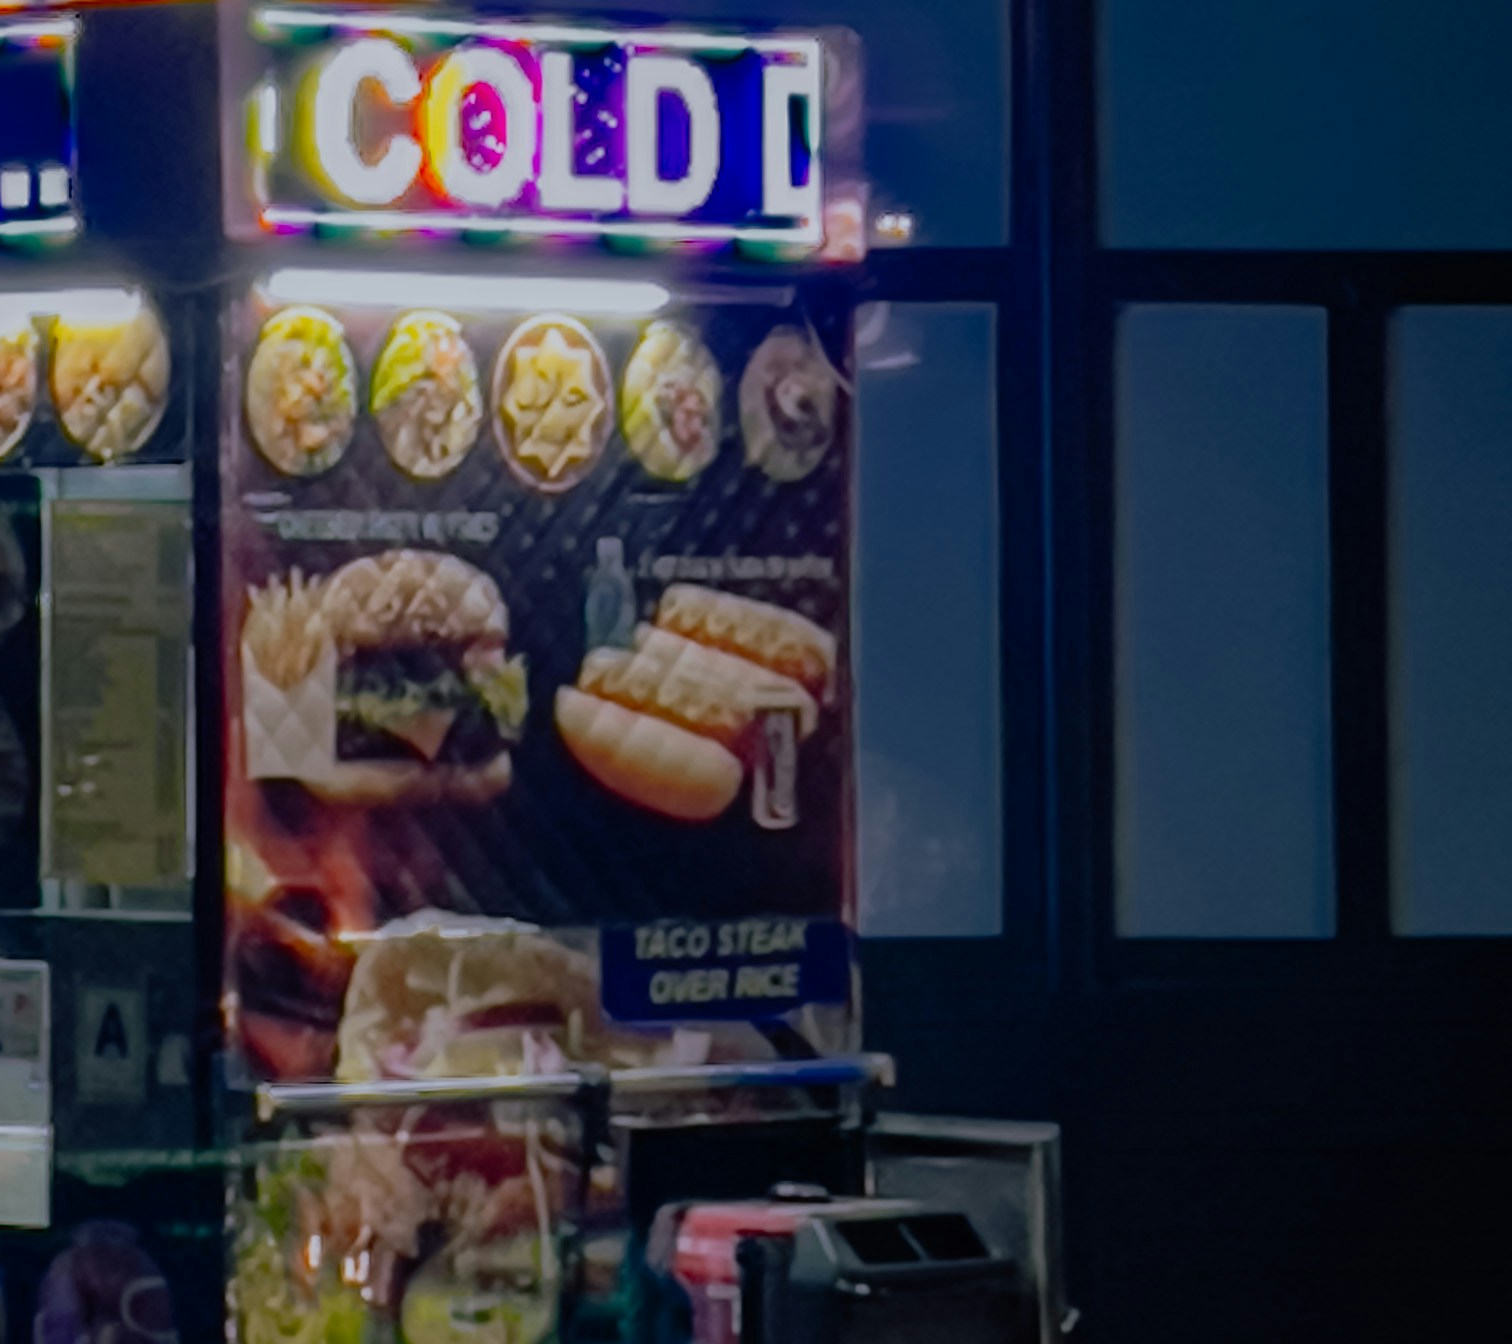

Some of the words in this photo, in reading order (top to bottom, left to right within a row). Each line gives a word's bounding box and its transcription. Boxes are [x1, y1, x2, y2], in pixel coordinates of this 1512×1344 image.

[315, 36, 723, 216] COLD
[634, 922, 711, 960] TACO
[716, 915, 808, 956] STEAK
[648, 967, 730, 1006] OVER
[733, 961, 801, 999] RICE
[94, 1001, 129, 1059] A
